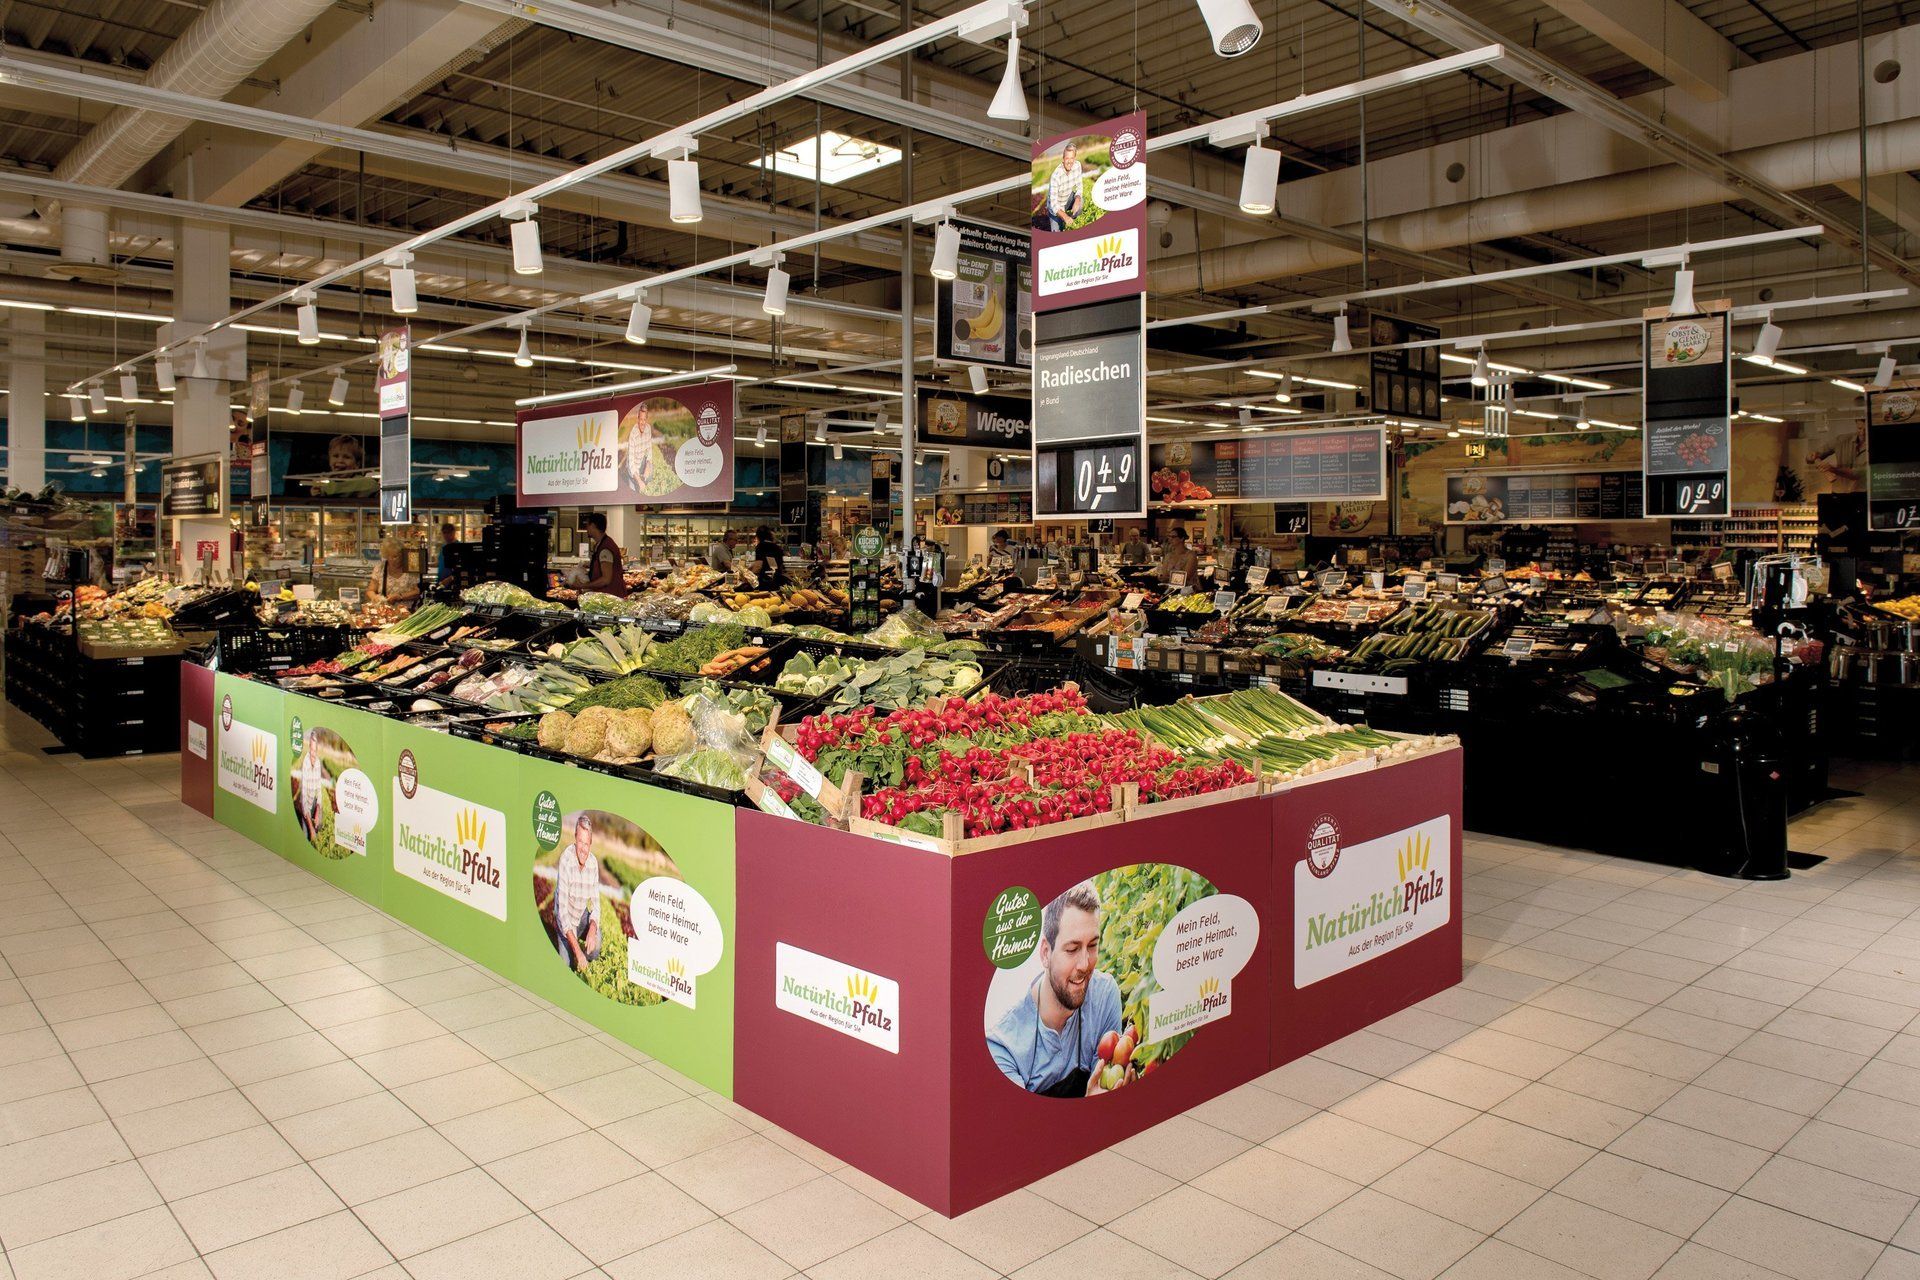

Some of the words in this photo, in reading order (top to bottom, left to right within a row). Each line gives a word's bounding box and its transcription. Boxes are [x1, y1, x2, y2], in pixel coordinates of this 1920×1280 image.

[1104, 177, 1117, 186] Mein
[1104, 185, 1120, 194] meine
[1104, 193, 1119, 203] beste
[1119, 190, 1133, 199] Ware
[959, 225, 983, 238] aktuelle
[983, 231, 1017, 248] Empfehlung
[1016, 239, 1031, 250] Ihres
[985, 243, 999, 252] Obst
[1004, 247, 1027, 259] Gemüse
[1070, 346, 1099, 359] Deutschland
[1041, 361, 1131, 389] Radieschen
[1046, 396, 1060, 406] Bund
[527, 448, 612, 475] NatürlichPfalz
[399, 823, 500, 889] NatürlichPfalz
[423, 867, 432, 878] Aus
[431, 871, 440, 881] der
[440, 874, 455, 888] Region
[455, 880, 464, 892] für
[648, 889, 667, 903] Mein
[667, 894, 686, 913] Feld,
[996, 892, 1029, 921] Gutes
[1305, 869, 1444, 951] NatürlichPfalz
[648, 906, 672, 922] meine
[671, 912, 702, 935] Heimat,
[995, 918, 1014, 934] aus
[1015, 911, 1033, 928] der
[1176, 920, 1198, 935] Mein
[1199, 912, 1221, 928] Feld,
[648, 922, 670, 938] beste
[669, 929, 689, 946] Ware
[991, 930, 1036, 960] Heimat
[1176, 937, 1203, 954] meine
[1204, 926, 1238, 945] Heimat,
[1348, 945, 1361, 957] Aus
[1361, 938, 1373, 952] der
[1373, 929, 1395, 947] Region
[1394, 925, 1405, 940] für
[1405, 920, 1414, 934] Sie
[1175, 954, 1201, 972] beste
[1202, 947, 1225, 963] Ware
[782, 975, 892, 1032] NatürlichPfalz
[1153, 992, 1228, 1031] NatürlichPfalz
[809, 1008, 819, 1017] Aus
[819, 1011, 828, 1020] der
[828, 1014, 845, 1025] Region
[853, 1024, 862, 1033] Sie
